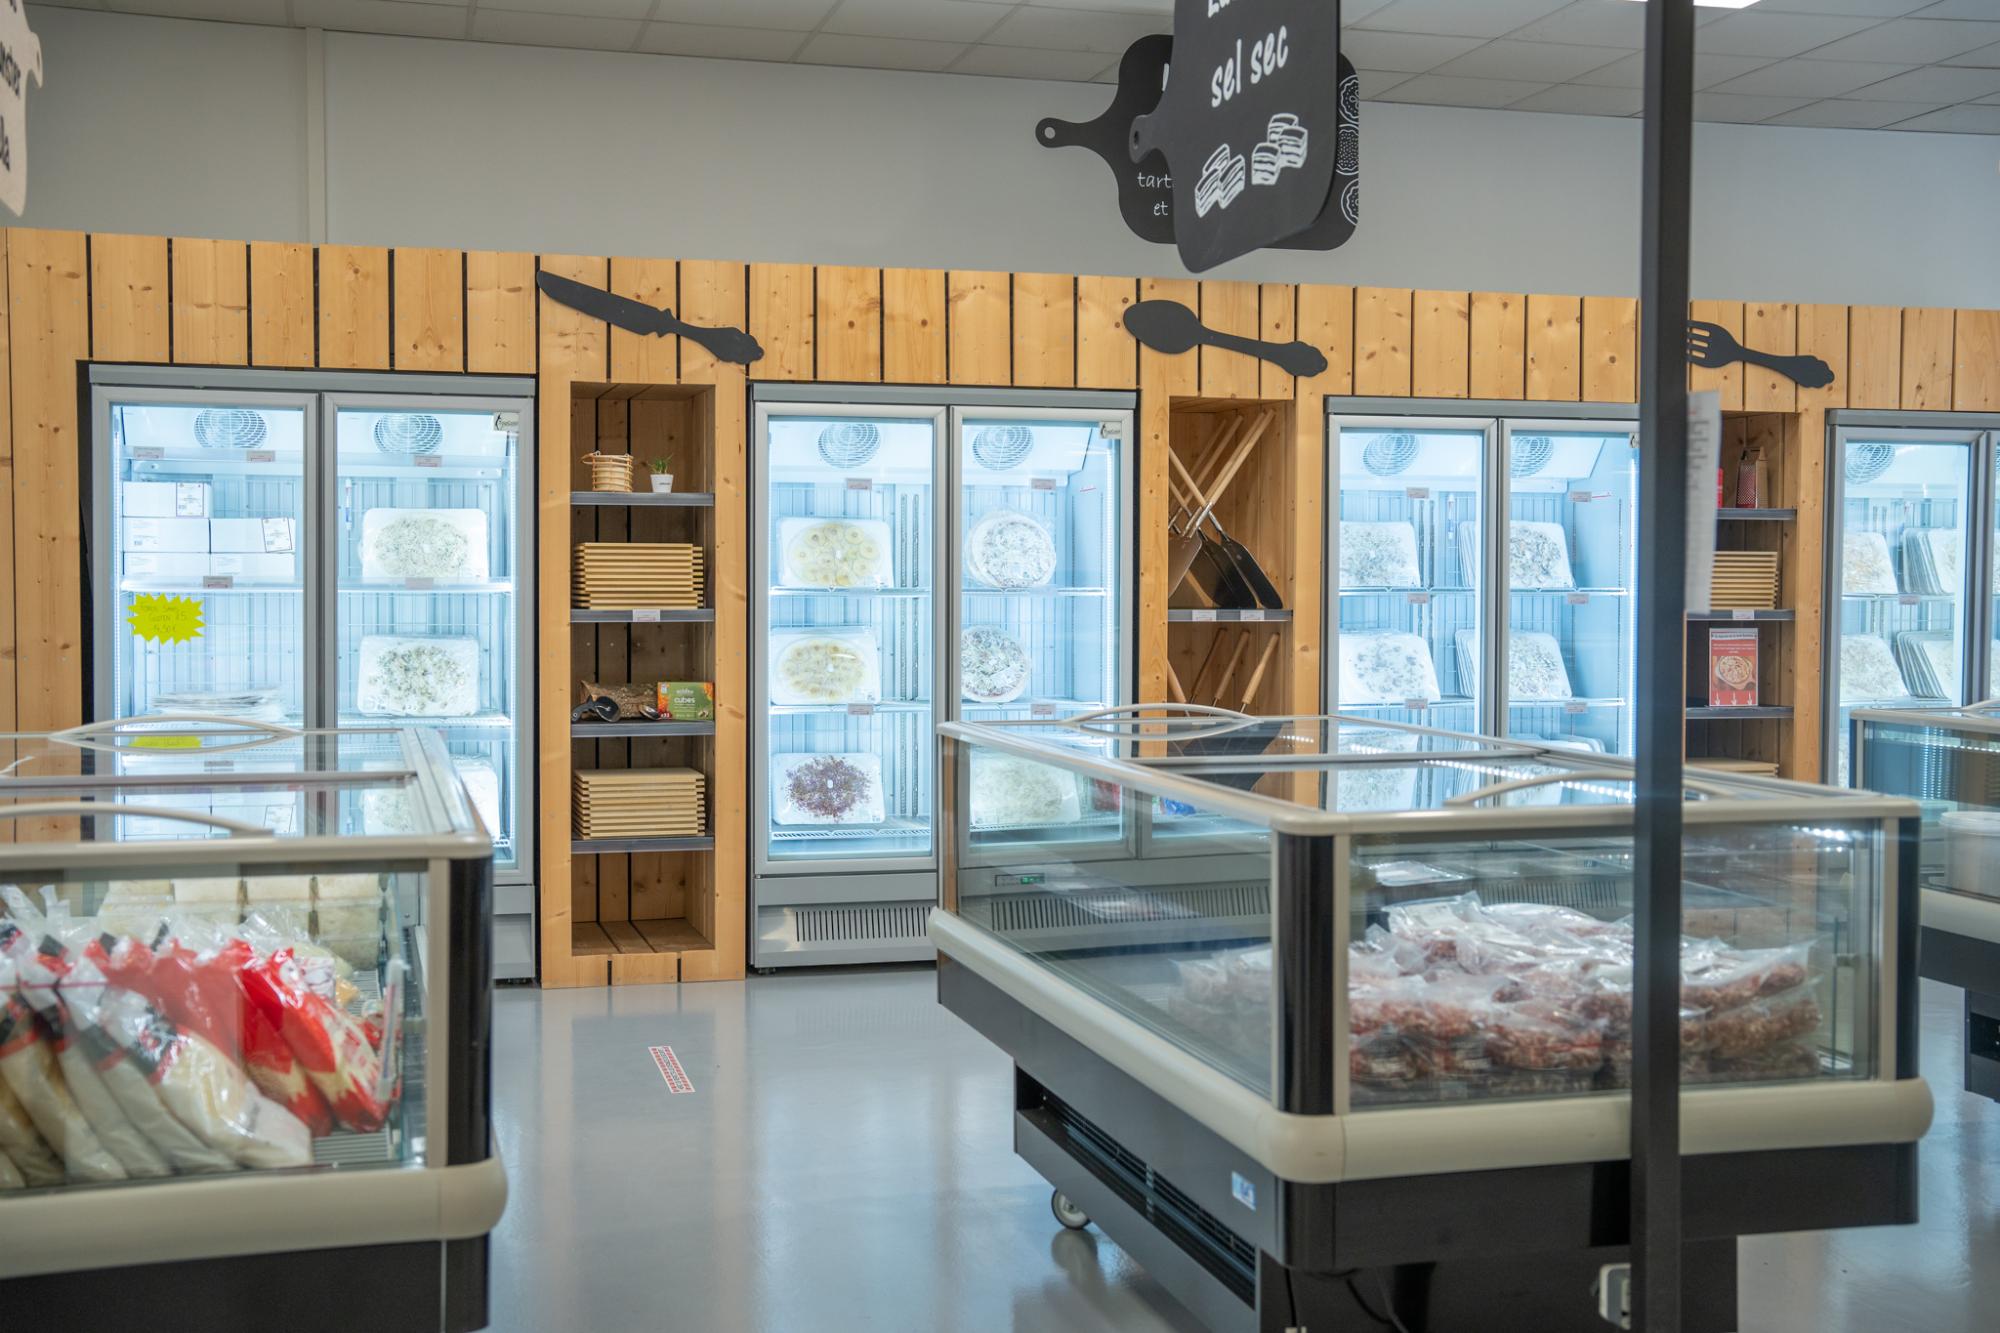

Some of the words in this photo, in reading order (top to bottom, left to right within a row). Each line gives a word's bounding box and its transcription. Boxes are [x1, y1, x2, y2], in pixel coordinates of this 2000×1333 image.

[1211, 38, 1243, 108] sel
[1251, 25, 1289, 85] sec
[1137, 172, 1174, 189] tart
[1153, 201, 1169, 216] et
